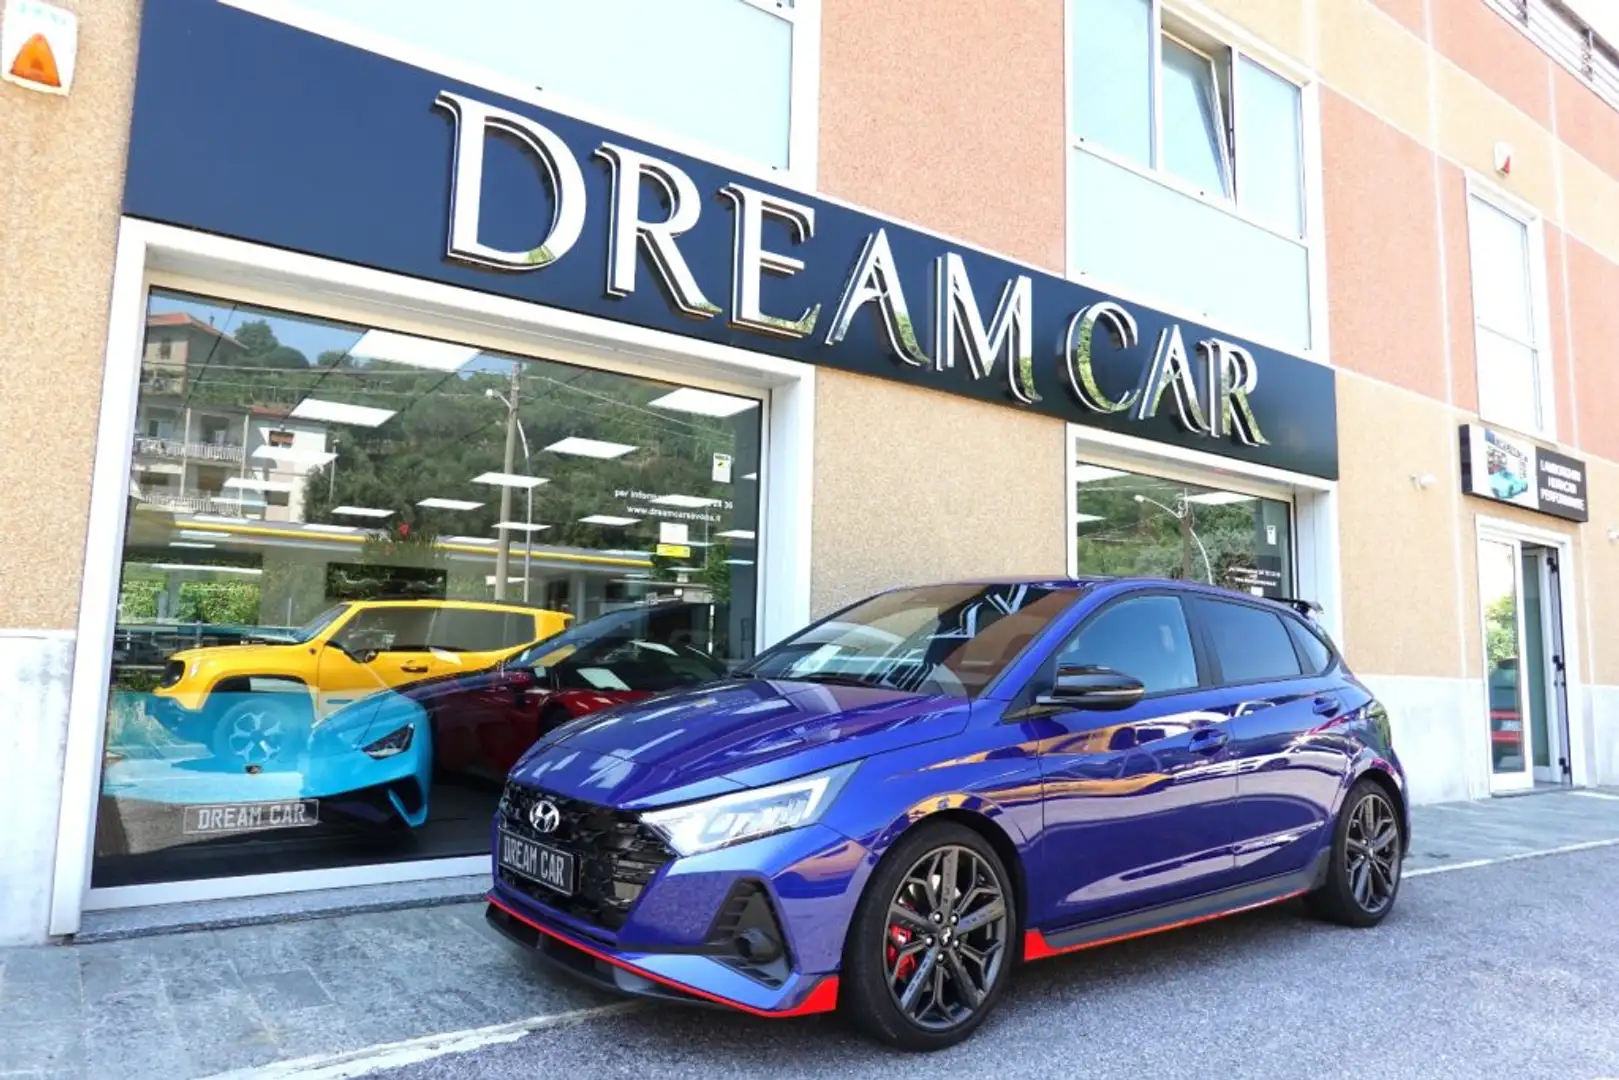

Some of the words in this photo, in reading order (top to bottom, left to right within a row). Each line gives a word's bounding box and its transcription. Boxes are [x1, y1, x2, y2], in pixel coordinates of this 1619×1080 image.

[434, 90, 1042, 403] DREAM
[1065, 301, 1270, 447] CAR
[197, 808, 262, 830] DREAM
[269, 803, 306, 825] CAR
[503, 836, 537, 875] DREAM
[540, 850, 565, 887] CAR
